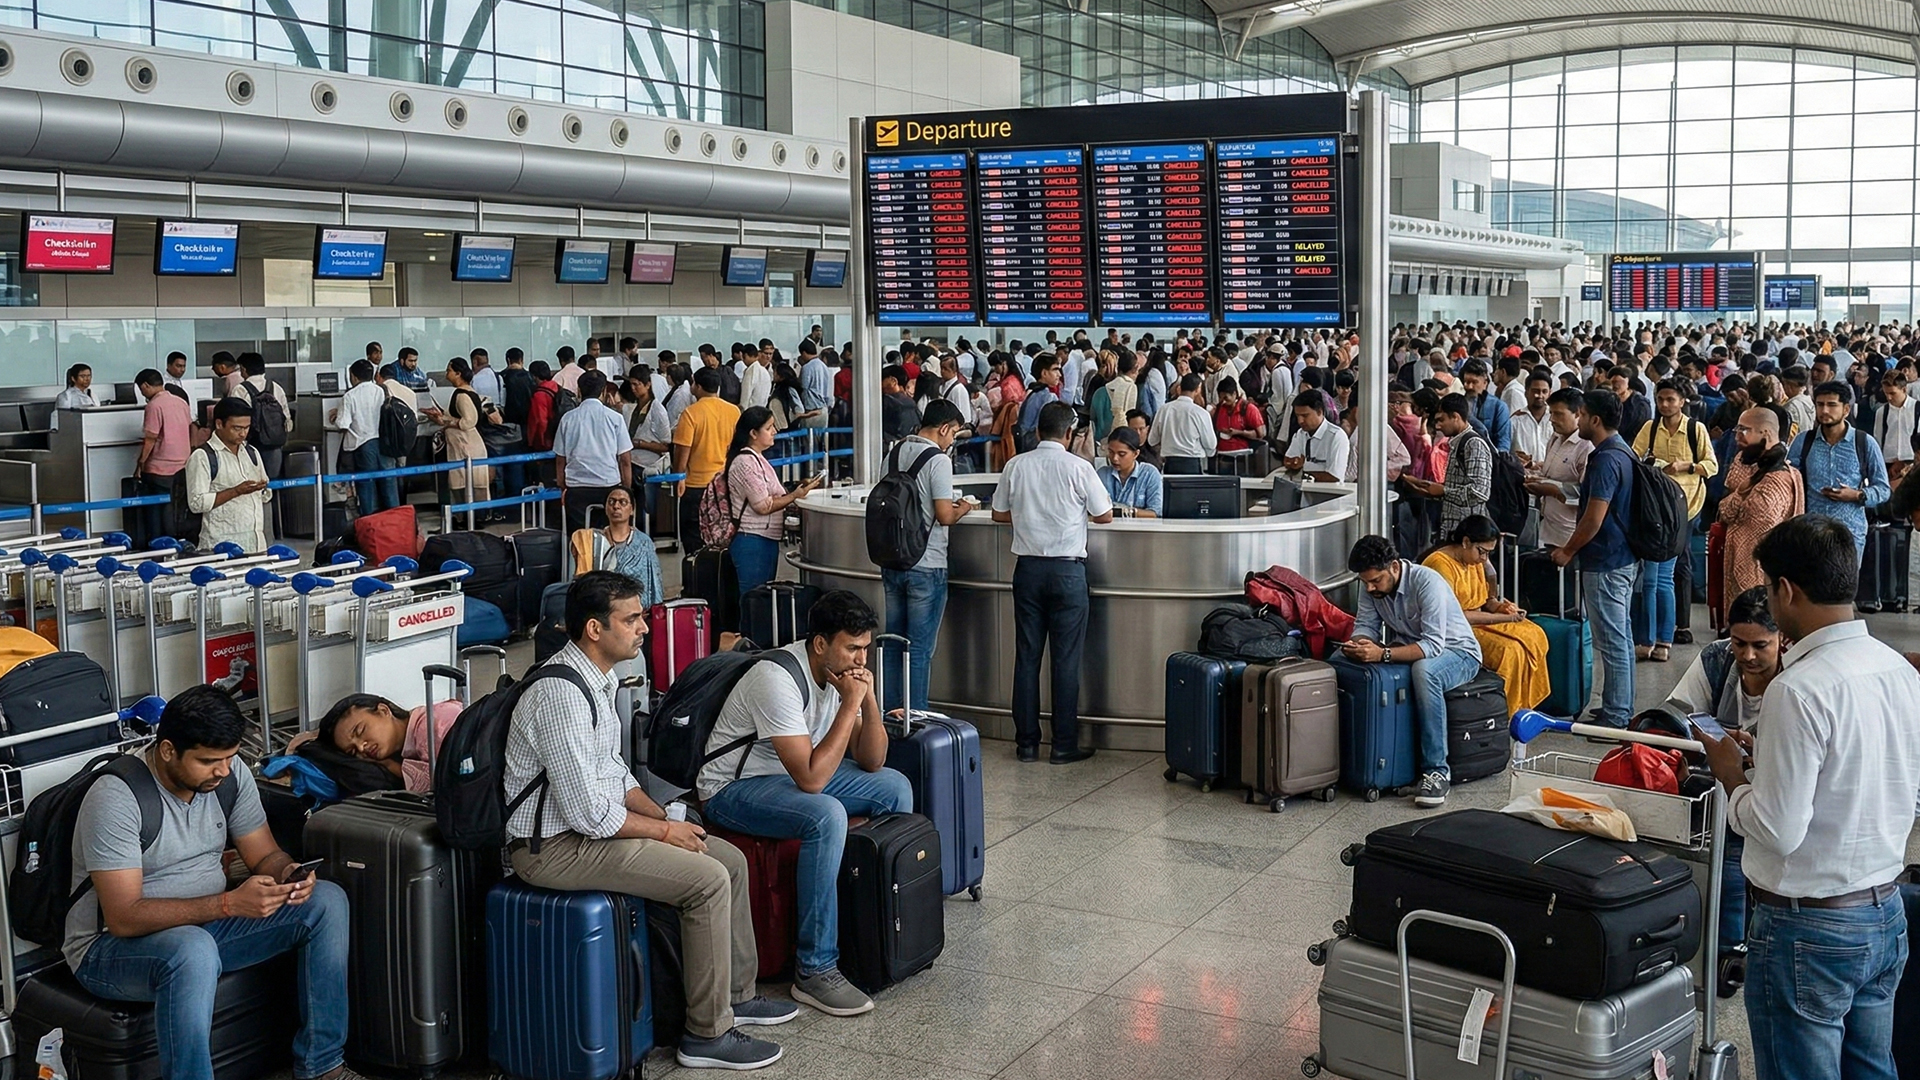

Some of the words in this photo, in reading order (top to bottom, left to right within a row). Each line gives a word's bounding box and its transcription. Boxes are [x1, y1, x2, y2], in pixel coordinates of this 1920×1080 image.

[906, 119, 1012, 145] Departure
[1294, 255, 1326, 263] DELAYED
[398, 606, 455, 628] CANCELLED
